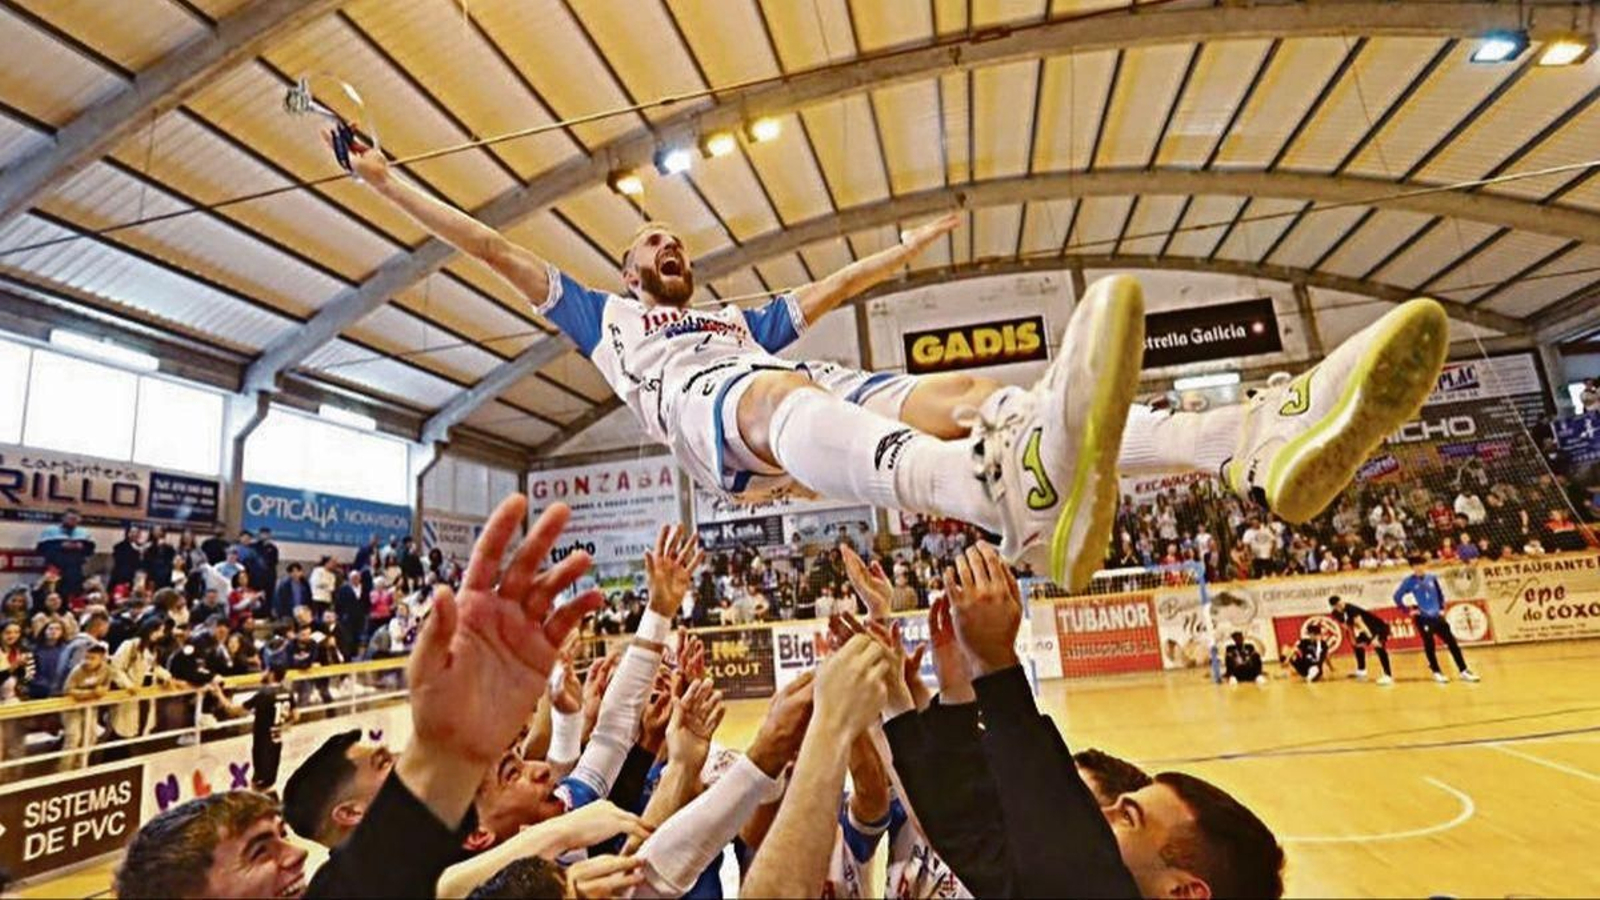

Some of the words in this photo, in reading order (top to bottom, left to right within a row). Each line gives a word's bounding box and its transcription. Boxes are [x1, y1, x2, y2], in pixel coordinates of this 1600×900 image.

[912, 321, 1041, 364] GADIS
[1142, 332, 1189, 350] trella
[1190, 323, 1246, 344] Galicia
[532, 465, 673, 500] GONZABA
[1483, 559, 1596, 578] RESTAURANTE
[1058, 602, 1152, 633] TUBANOR
[23, 780, 132, 829] SISTEMAS
[22, 825, 67, 862] DE
[72, 810, 126, 847] PVC
